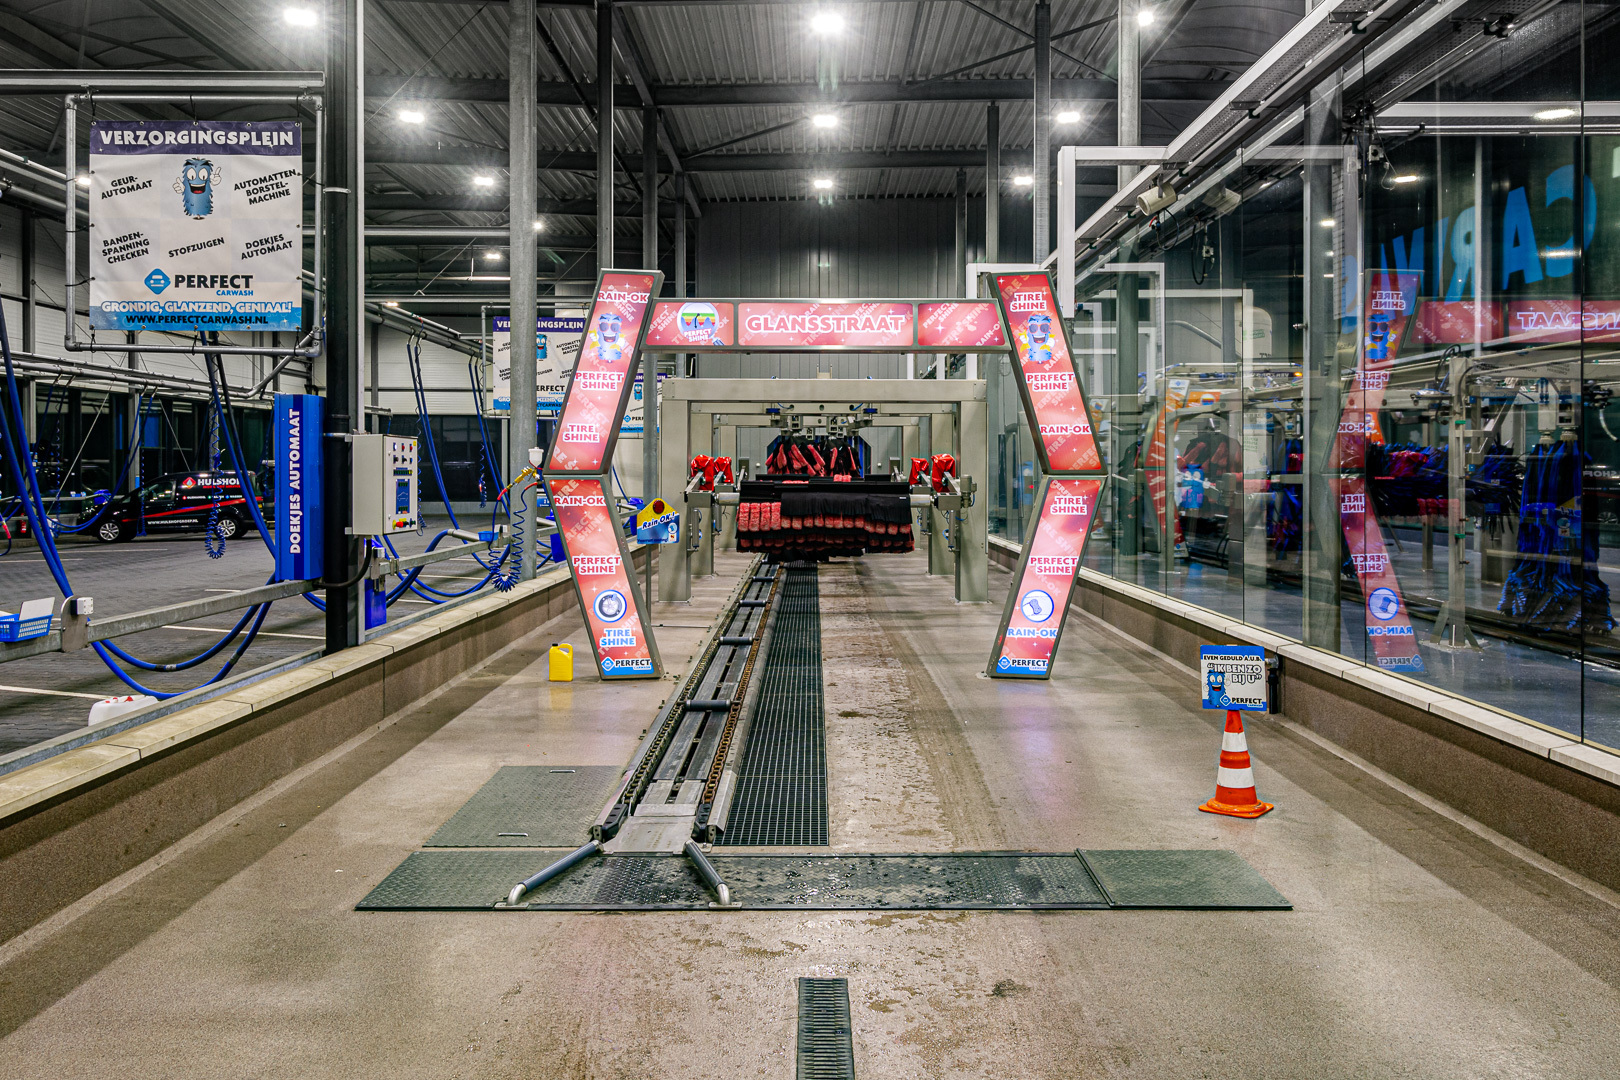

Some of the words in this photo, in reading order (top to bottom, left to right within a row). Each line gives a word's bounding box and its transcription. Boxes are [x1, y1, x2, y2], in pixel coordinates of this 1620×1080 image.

[100, 130, 294, 147] VERZORGINGSPLEIN
[110, 175, 138, 188] GEUR-
[234, 169, 297, 191] AUTOMATTEN
[101, 180, 153, 199] AUTOMAAT
[246, 181, 289, 197] BORSTEL-
[248, 189, 291, 205] MACHINE
[103, 232, 144, 247] BANDEN-
[245, 234, 285, 250] DOEKJES
[102, 238, 150, 257] SPANNING
[168, 237, 225, 258] STOFZUIGEN
[241, 241, 293, 260] AUTOMAAT
[107, 248, 149, 264] CHECKEN
[174, 275, 253, 289] PERFECT
[216, 289, 254, 297] CARWASH
[598, 292, 649, 303] RAIN-OK
[1016, 293, 1041, 301] TIRE
[236, 302, 292, 313] GENIAAL!
[1011, 301, 1046, 311] SHINE
[126, 315, 269, 325] WWW.PERFECTCARWASH.NL
[746, 315, 905, 333] GLANSSTRAAT
[683, 328, 712, 338] PERFECT
[976, 321, 1000, 347] RAIN-O
[688, 335, 709, 343] SHINE
[575, 372, 624, 381] PERFECT
[1027, 373, 1074, 382] PERFECT
[582, 381, 616, 390] SHINE
[1033, 382, 1068, 391] SHINE
[568, 424, 594, 433] TIRE
[1040, 425, 1090, 433] RAIN-OK
[564, 433, 599, 442] SHINE
[289, 408, 301, 490] AUTOMAAT
[554, 497, 604, 505] RAIN-OK
[1057, 497, 1082, 505] TIRE
[1051, 505, 1086, 514] SHINE
[290, 494, 303, 553] DOEKJES
[642, 518, 658, 529] Rain
[573, 557, 621, 565] PERFECT
[1030, 557, 1078, 565] PERFECT
[580, 565, 614, 574] SHINE
[1036, 565, 1071, 574] SHINE
[605, 629, 631, 637] TIRE
[1007, 628, 1057, 637] RAIN-OK
[601, 637, 635, 646] SHINE
[615, 659, 651, 667] PERFECT
[1011, 659, 1048, 667] PERFECT
[1226, 664, 1246, 674] BEN
[1246, 665, 1262, 674] ZO
[1232, 674, 1246, 686] BIJ
